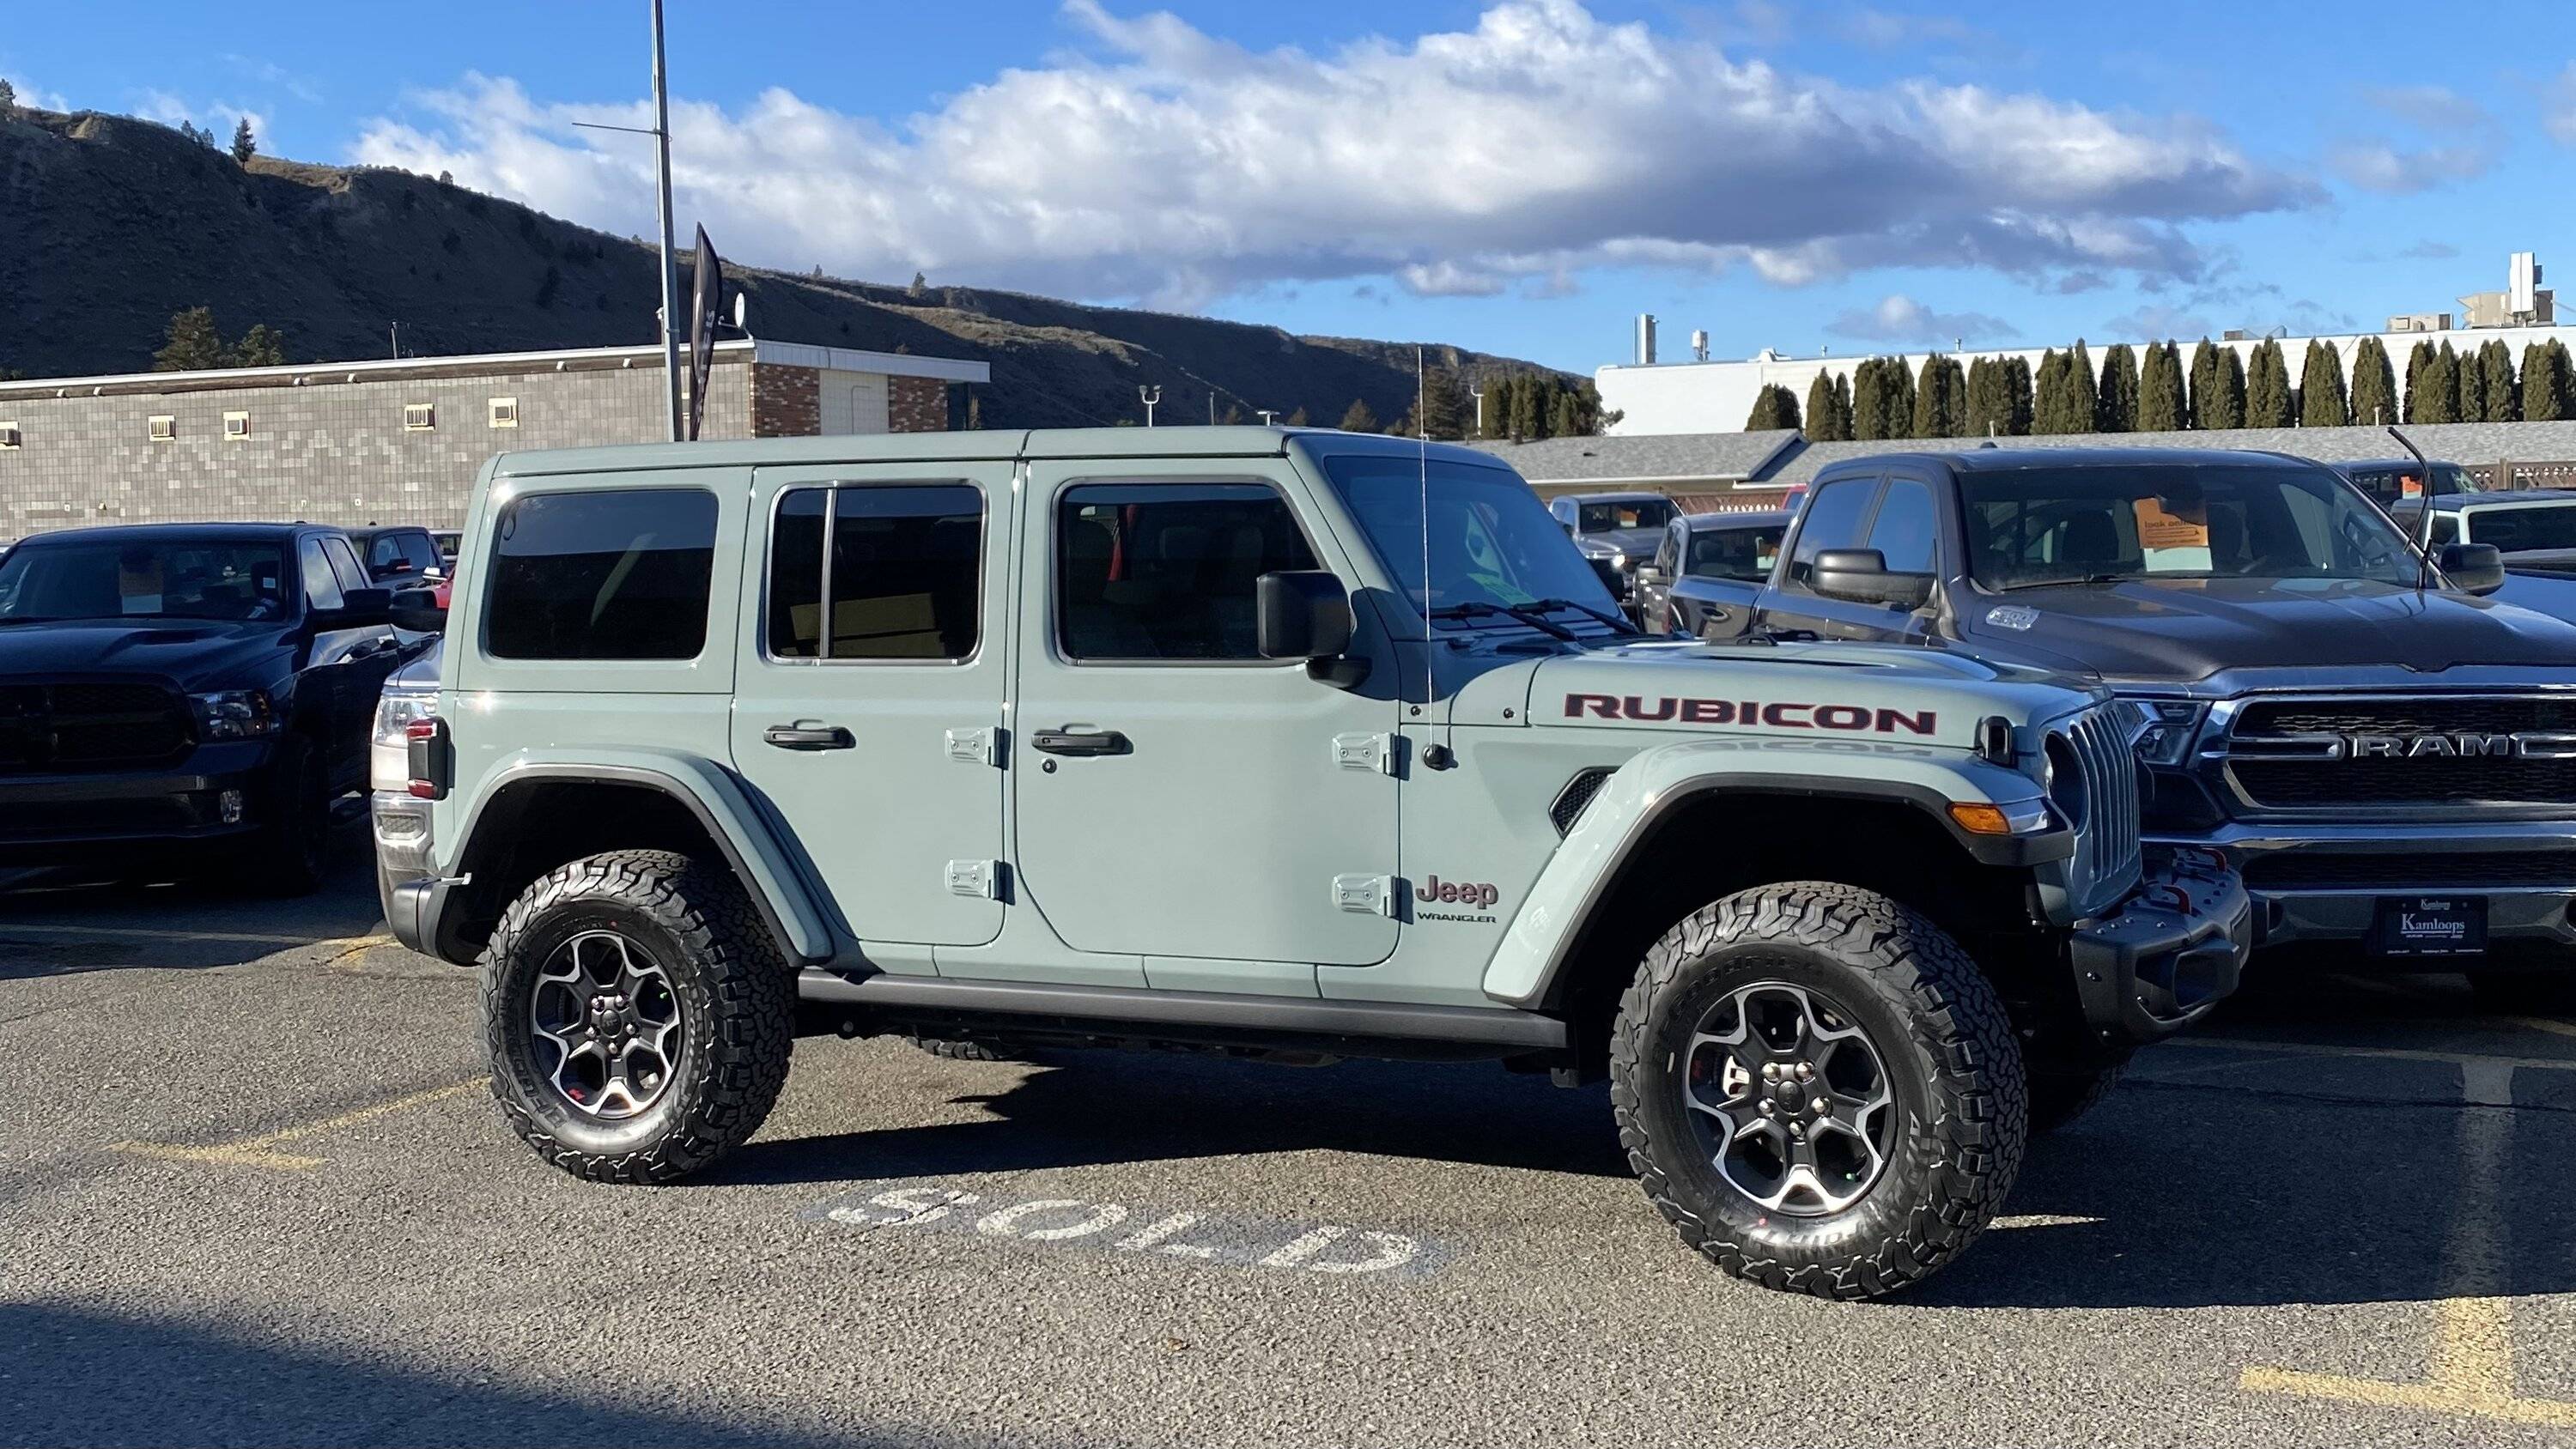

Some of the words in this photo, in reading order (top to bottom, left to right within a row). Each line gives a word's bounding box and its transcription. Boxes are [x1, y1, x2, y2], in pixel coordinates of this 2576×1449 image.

[1564, 693, 1937, 736] RUBICON
[2342, 732, 2510, 757] RAM
[1415, 874, 1499, 910] Jeep
[1417, 912, 1497, 924] WRANGLER
[2401, 912, 2465, 934] Kamloops
[827, 1188, 1419, 1273] SOLD
